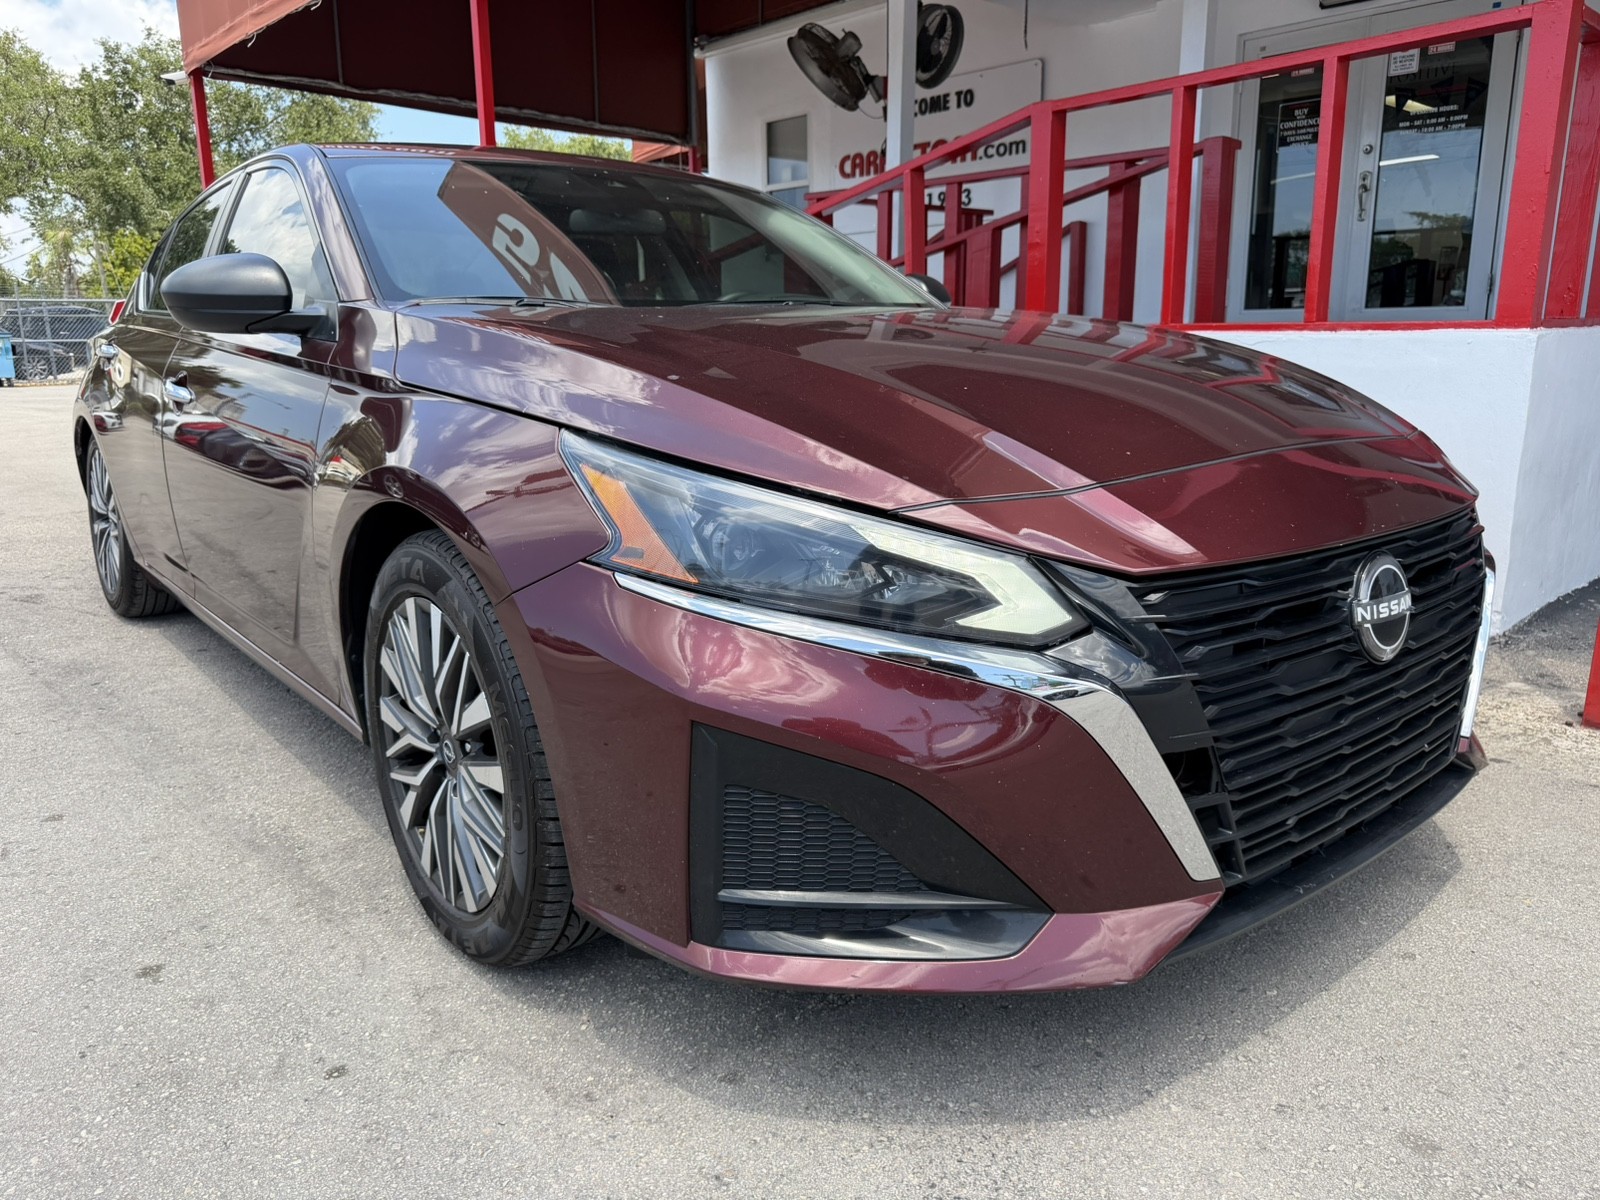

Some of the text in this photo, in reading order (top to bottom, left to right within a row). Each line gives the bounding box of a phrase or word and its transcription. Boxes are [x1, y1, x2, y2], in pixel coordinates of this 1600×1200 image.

[954, 88, 974, 109] TO
[1294, 107, 1309, 117] BUY
[1356, 592, 1412, 622] NISSAN
